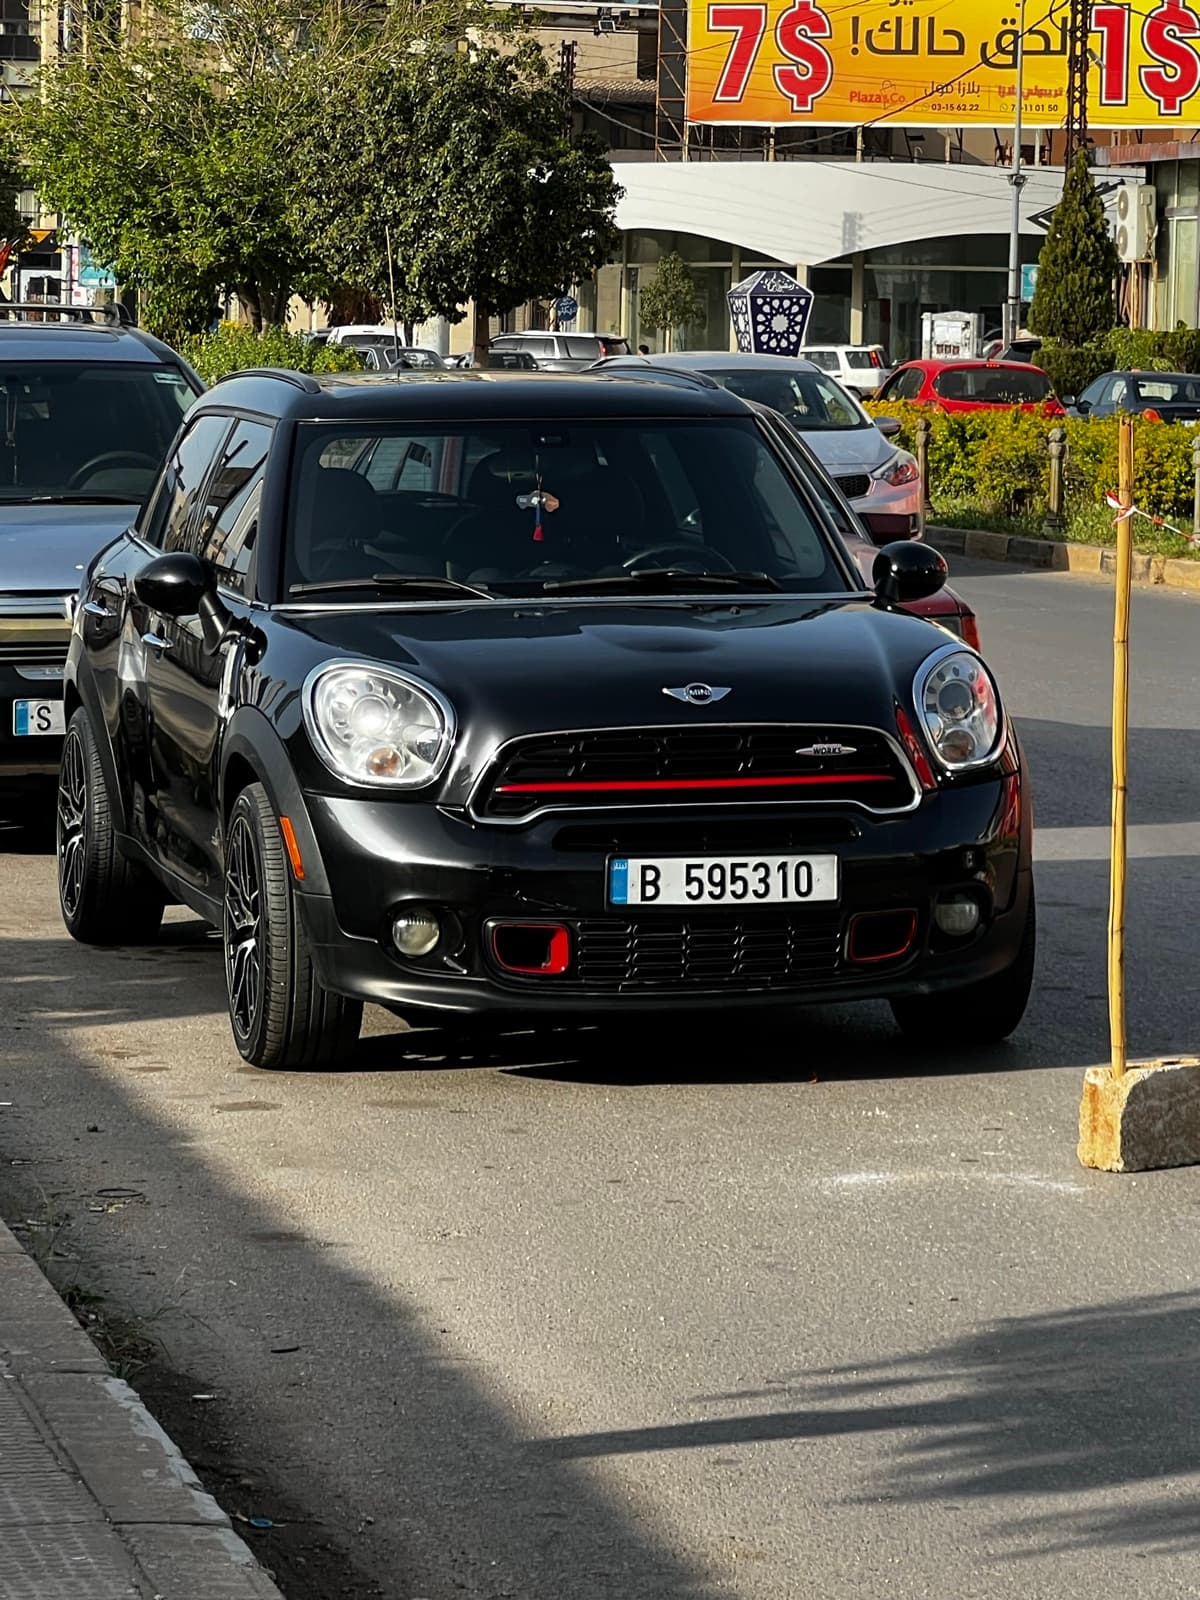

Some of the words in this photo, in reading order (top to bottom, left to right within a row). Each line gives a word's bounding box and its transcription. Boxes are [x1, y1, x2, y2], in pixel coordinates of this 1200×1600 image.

[851, 16, 965, 56] حالك!
[707, 0, 833, 113] 7$
[689, 688, 711, 696] MINI
[37, 705, 51, 731] S
[640, 864, 661, 902] B
[685, 861, 813, 900] 595310
